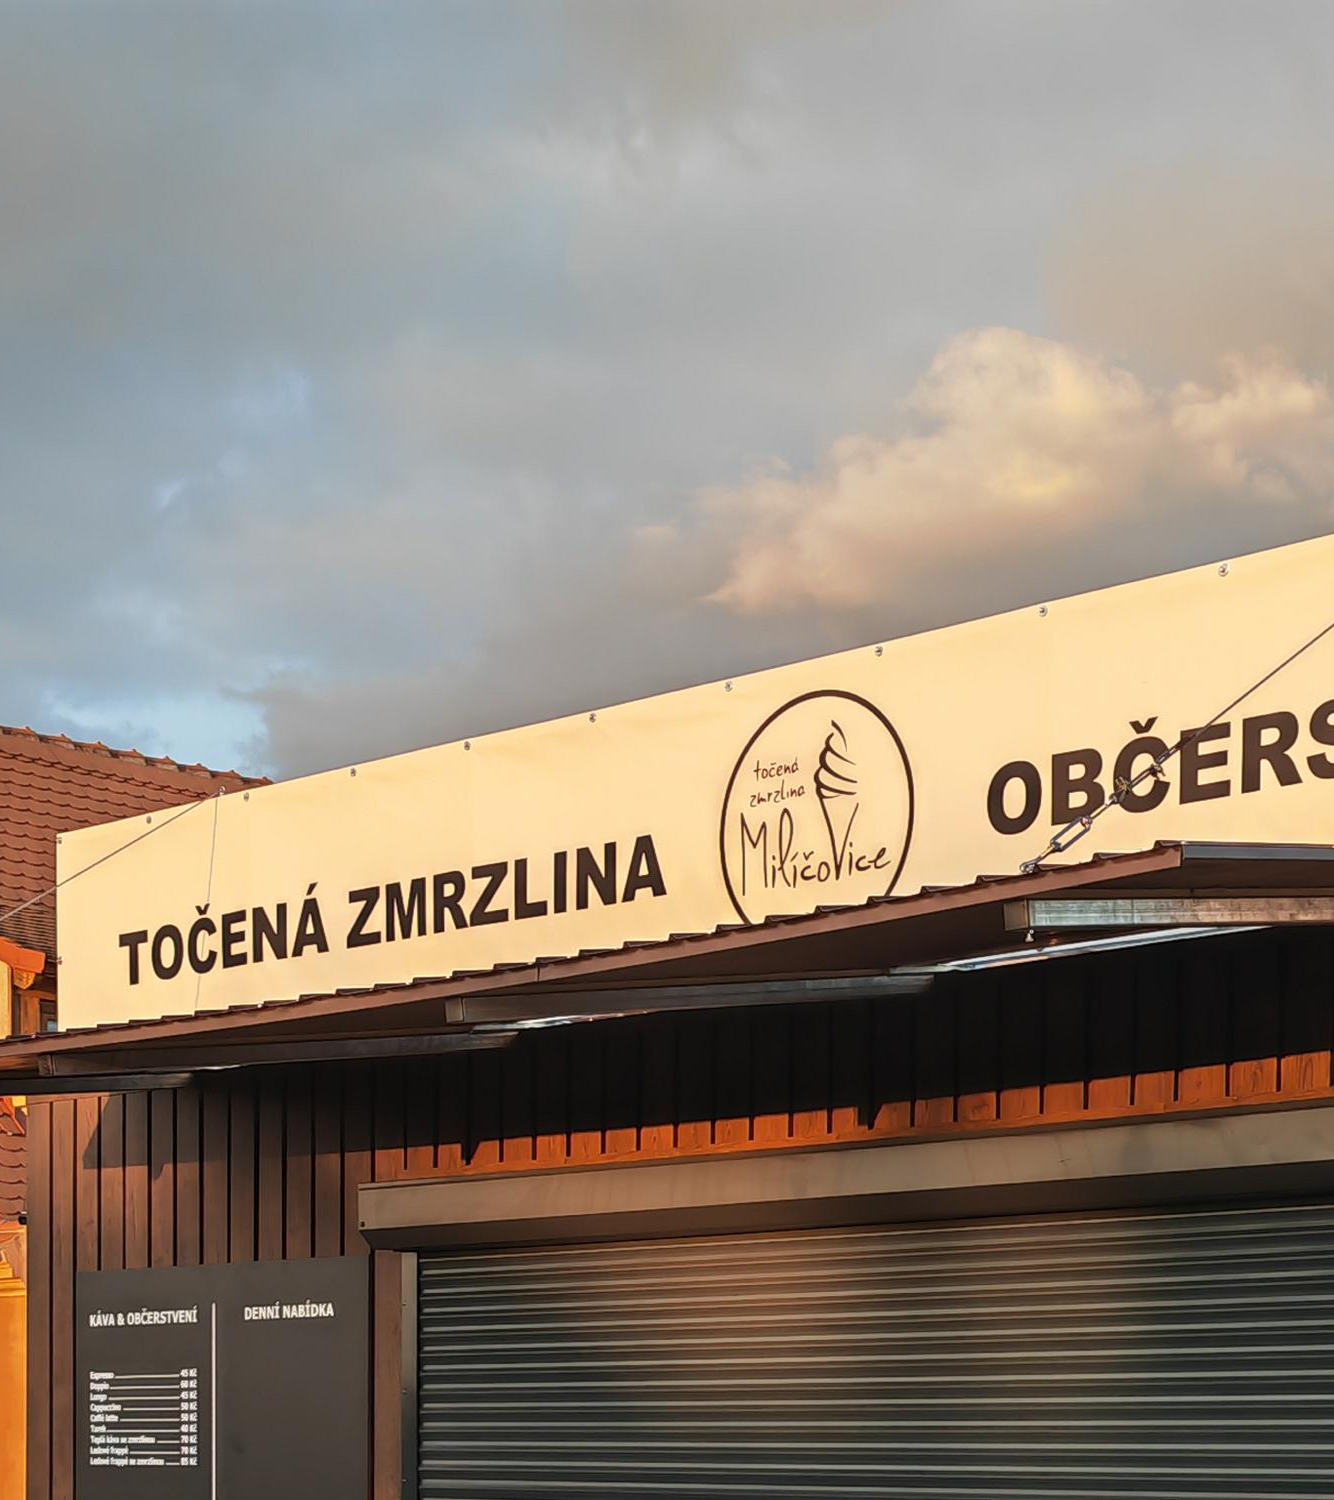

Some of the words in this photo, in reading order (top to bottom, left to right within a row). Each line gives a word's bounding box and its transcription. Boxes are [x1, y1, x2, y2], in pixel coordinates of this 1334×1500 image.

[753, 757, 799, 781] točená
[750, 779, 805, 807] zmrzlina
[119, 882, 329, 985] TOČENÁ
[346, 834, 668, 948] ZMRZLINA
[90, 1310, 115, 1327] KÁVA
[117, 1313, 125, 1326] &
[127, 1305, 198, 1326] OBČERSTVENÍ
[244, 1301, 280, 1320] DENNÍ
[282, 1299, 334, 1319] NABÍDKA
